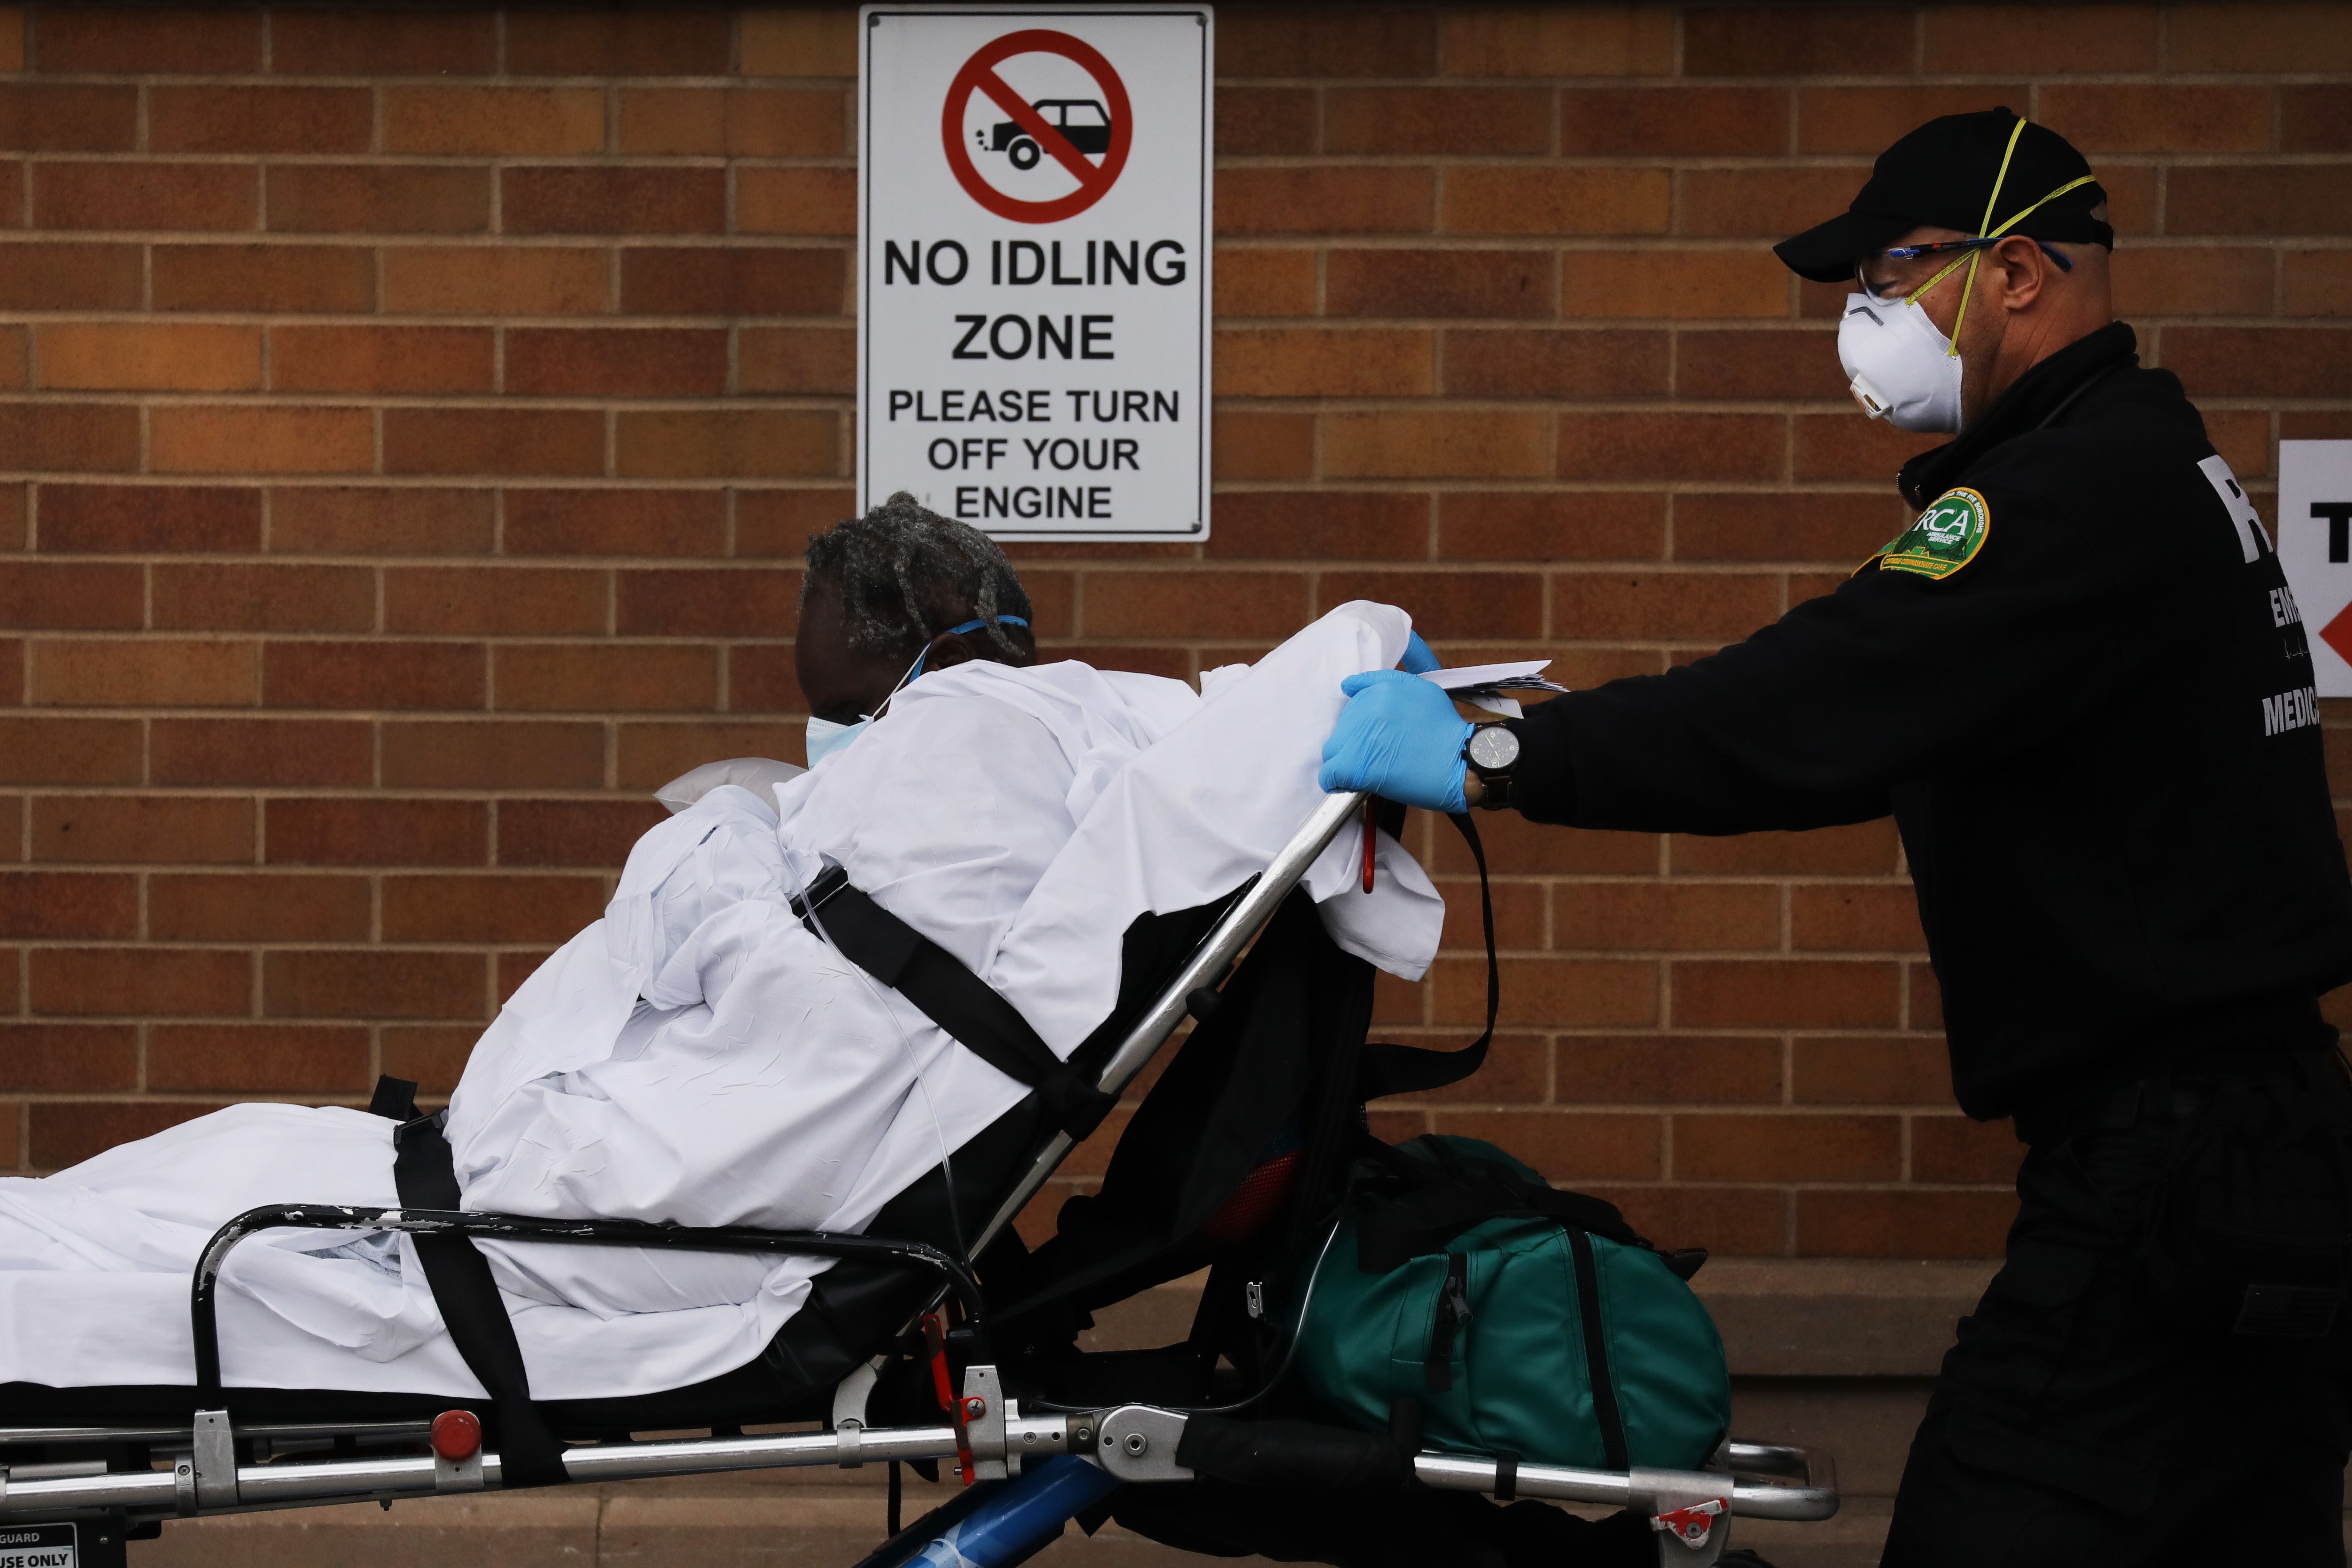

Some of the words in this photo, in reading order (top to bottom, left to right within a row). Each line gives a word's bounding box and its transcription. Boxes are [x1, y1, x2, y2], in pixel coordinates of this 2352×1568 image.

[885, 240, 968, 286] NO
[992, 240, 1186, 286] IDLING
[952, 314, 1114, 360] ZONE
[890, 390, 1050, 422] PLEASE
[1066, 390, 1178, 422] TURN
[928, 438, 1007, 470] OFF
[1023, 438, 1139, 470] YOUR
[956, 487, 1112, 518] ENGINE
[1966, 494, 1977, 503] FIVE
[1974, 501, 1985, 533] BOROUGHS
[1912, 508, 1969, 536] RCA
[1926, 531, 1961, 541] AMBULANCE
[1928, 536, 1953, 545] SERVICE
[0, 1533, 40, 1544] GUARD
[27, 1553, 68, 1568] ONLY
